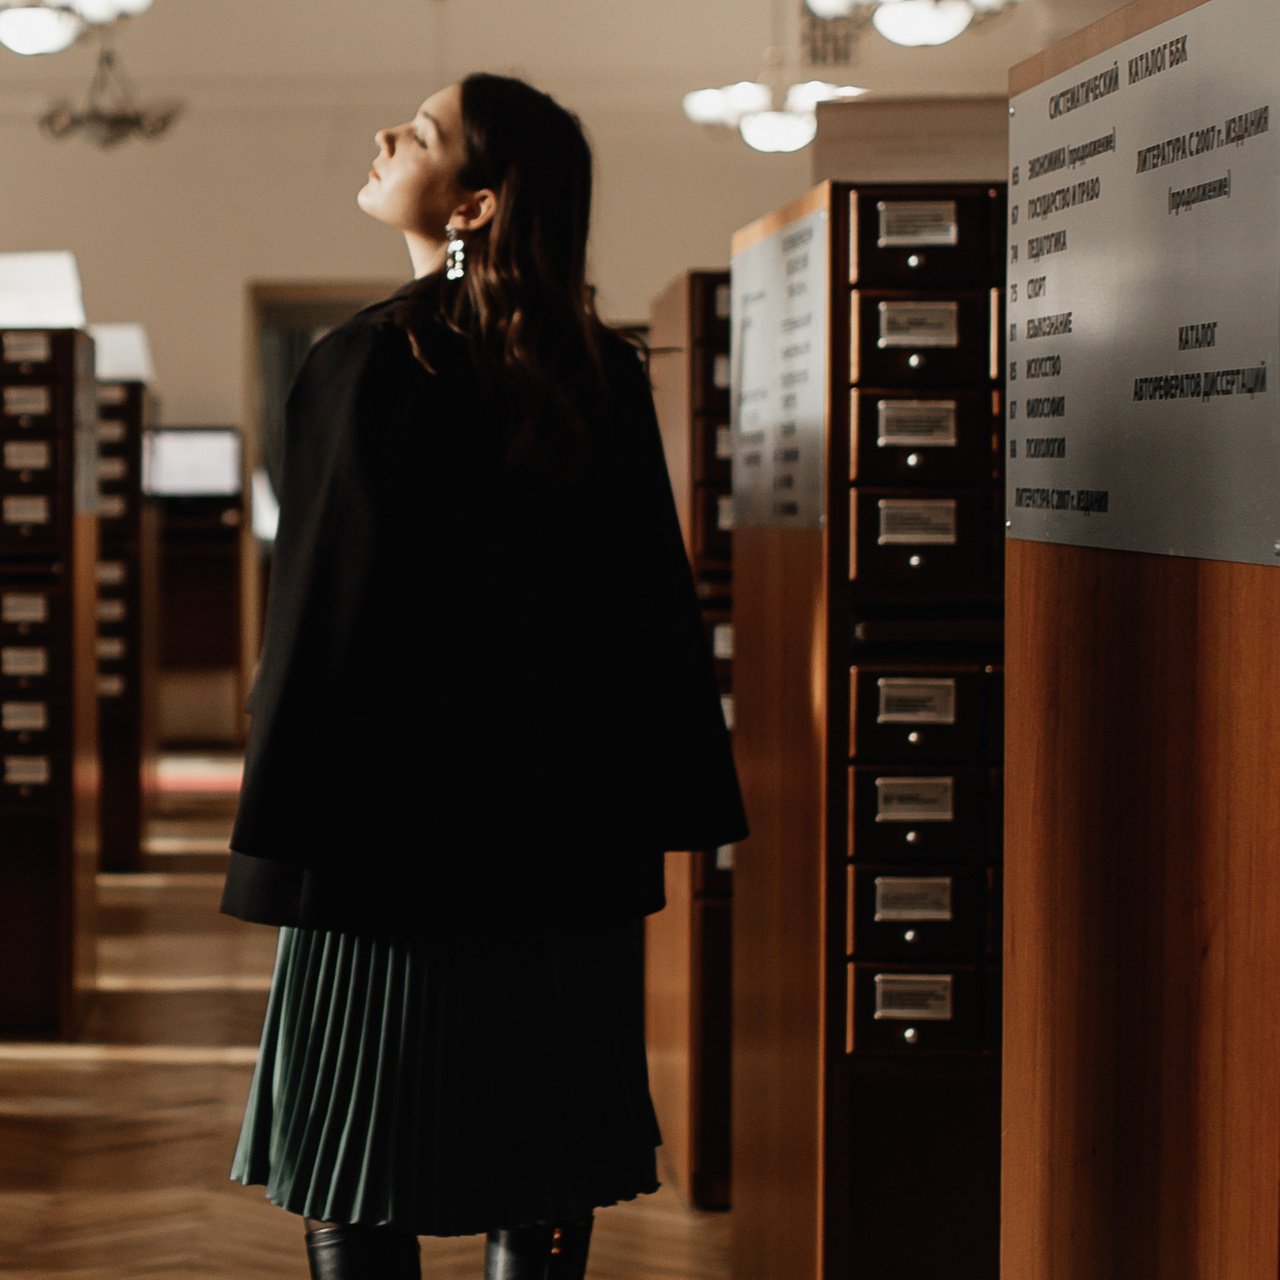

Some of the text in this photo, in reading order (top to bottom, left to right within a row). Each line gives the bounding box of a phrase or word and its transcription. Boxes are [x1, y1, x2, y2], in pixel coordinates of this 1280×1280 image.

[1048, 34, 1188, 120] СИСТЕМАТИЧЕСКИЙ КАТАЛОГ ББК
[1136, 134, 1188, 175] ЛИТЕРАТУРА
[1195, 124, 1216, 156] 2007
[1224, 105, 1270, 148] ИЗДАНИЯ
[1028, 146, 1066, 182] ЭКОНОМИКА
[1027, 186, 1070, 222] ГОСУДАРСТВО
[1076, 176, 1101, 205] ПРАВО
[1027, 229, 1068, 263] ПЕДАГОГИКА
[1027, 276, 1047, 299] СПОРТ
[1178, 321, 1218, 351] КАТАЛОГ
[1026, 354, 1061, 379] ИСКУССТВО
[1132, 360, 1267, 403] АВТОРЕФЕРАТОВ ДИССЕРТАЦИЙ
